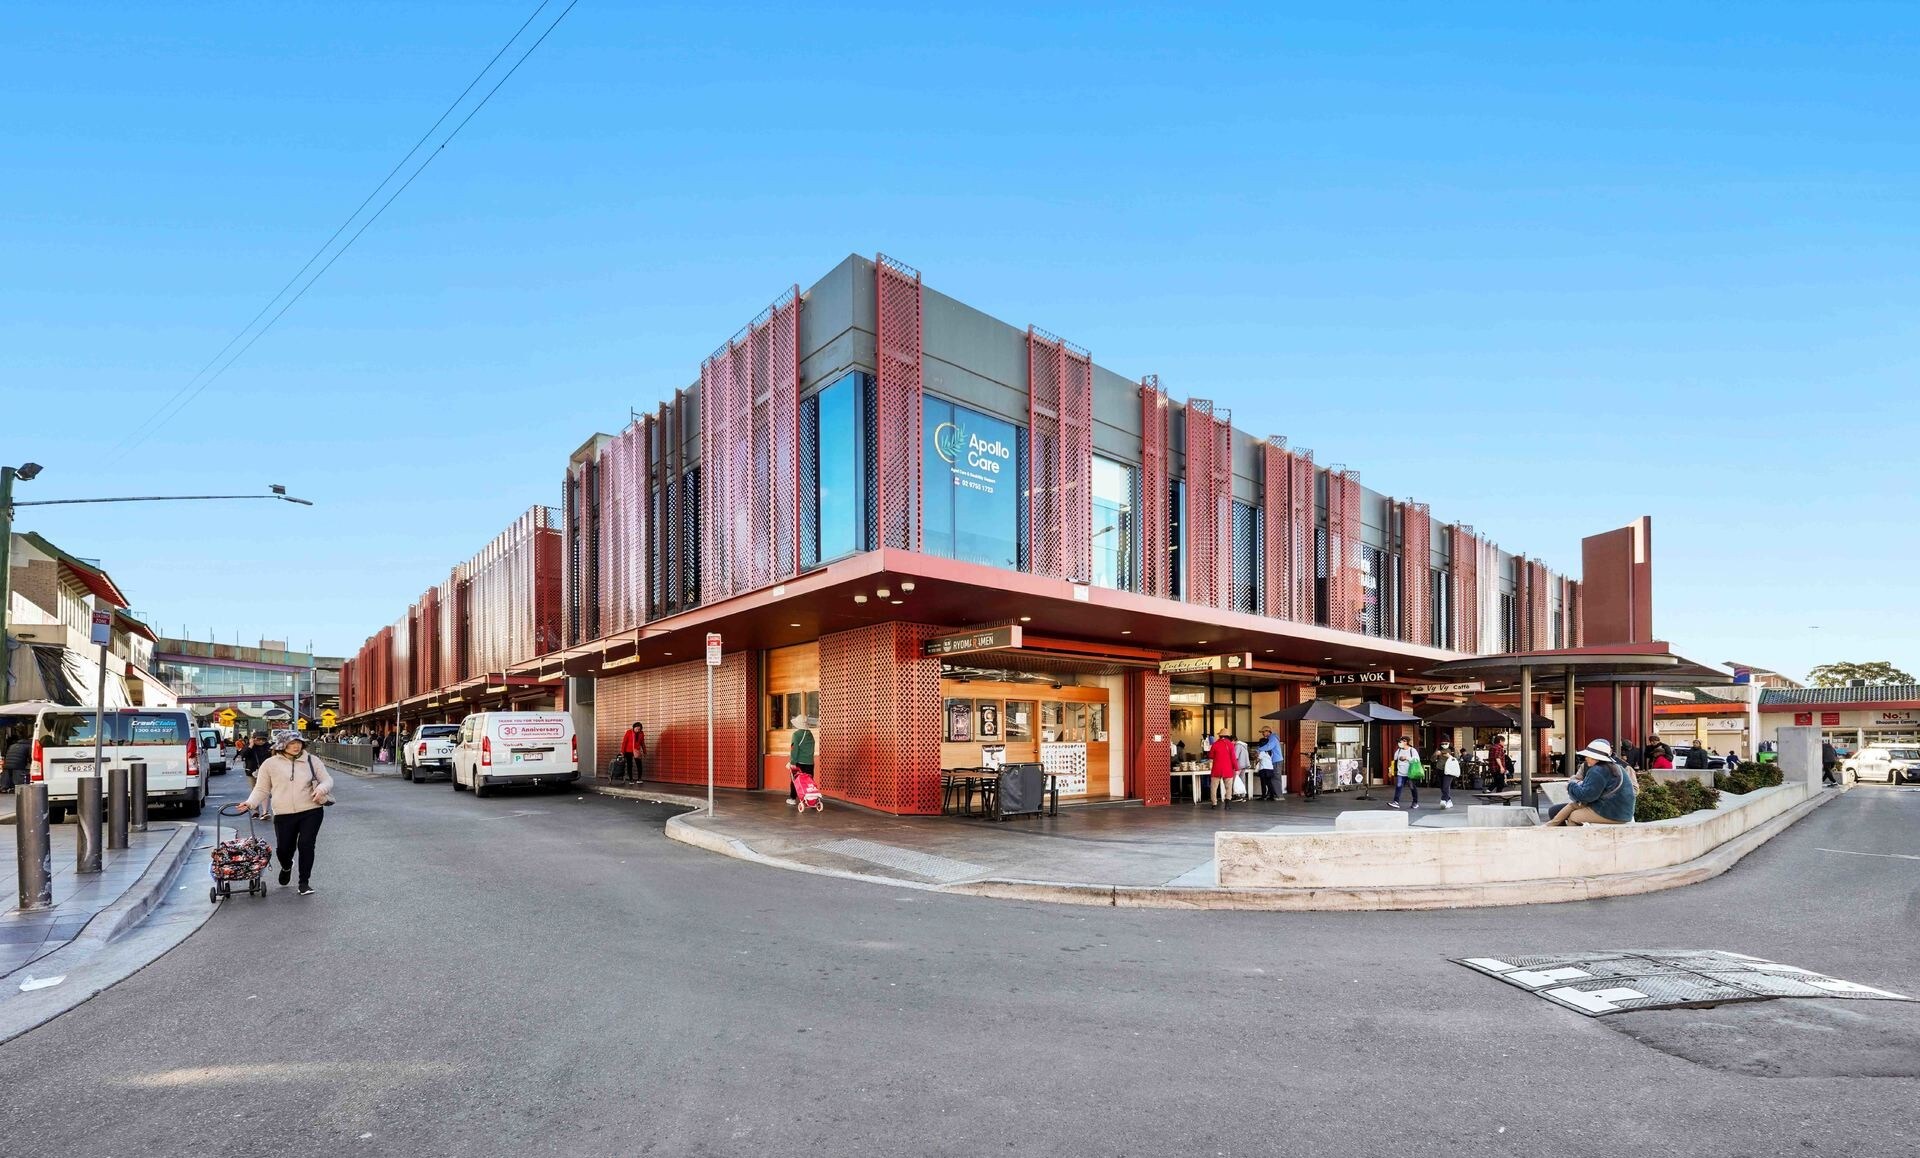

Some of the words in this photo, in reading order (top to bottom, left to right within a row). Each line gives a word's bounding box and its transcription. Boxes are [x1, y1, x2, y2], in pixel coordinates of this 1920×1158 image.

[969, 433, 1009, 459] Apollo
[968, 451, 1000, 473] Care
[1163, 660, 1191, 670] Lucky
[1333, 674, 1355, 684] LI'S
[1360, 672, 1385, 682] WOK
[504, 726, 518, 735] 30
